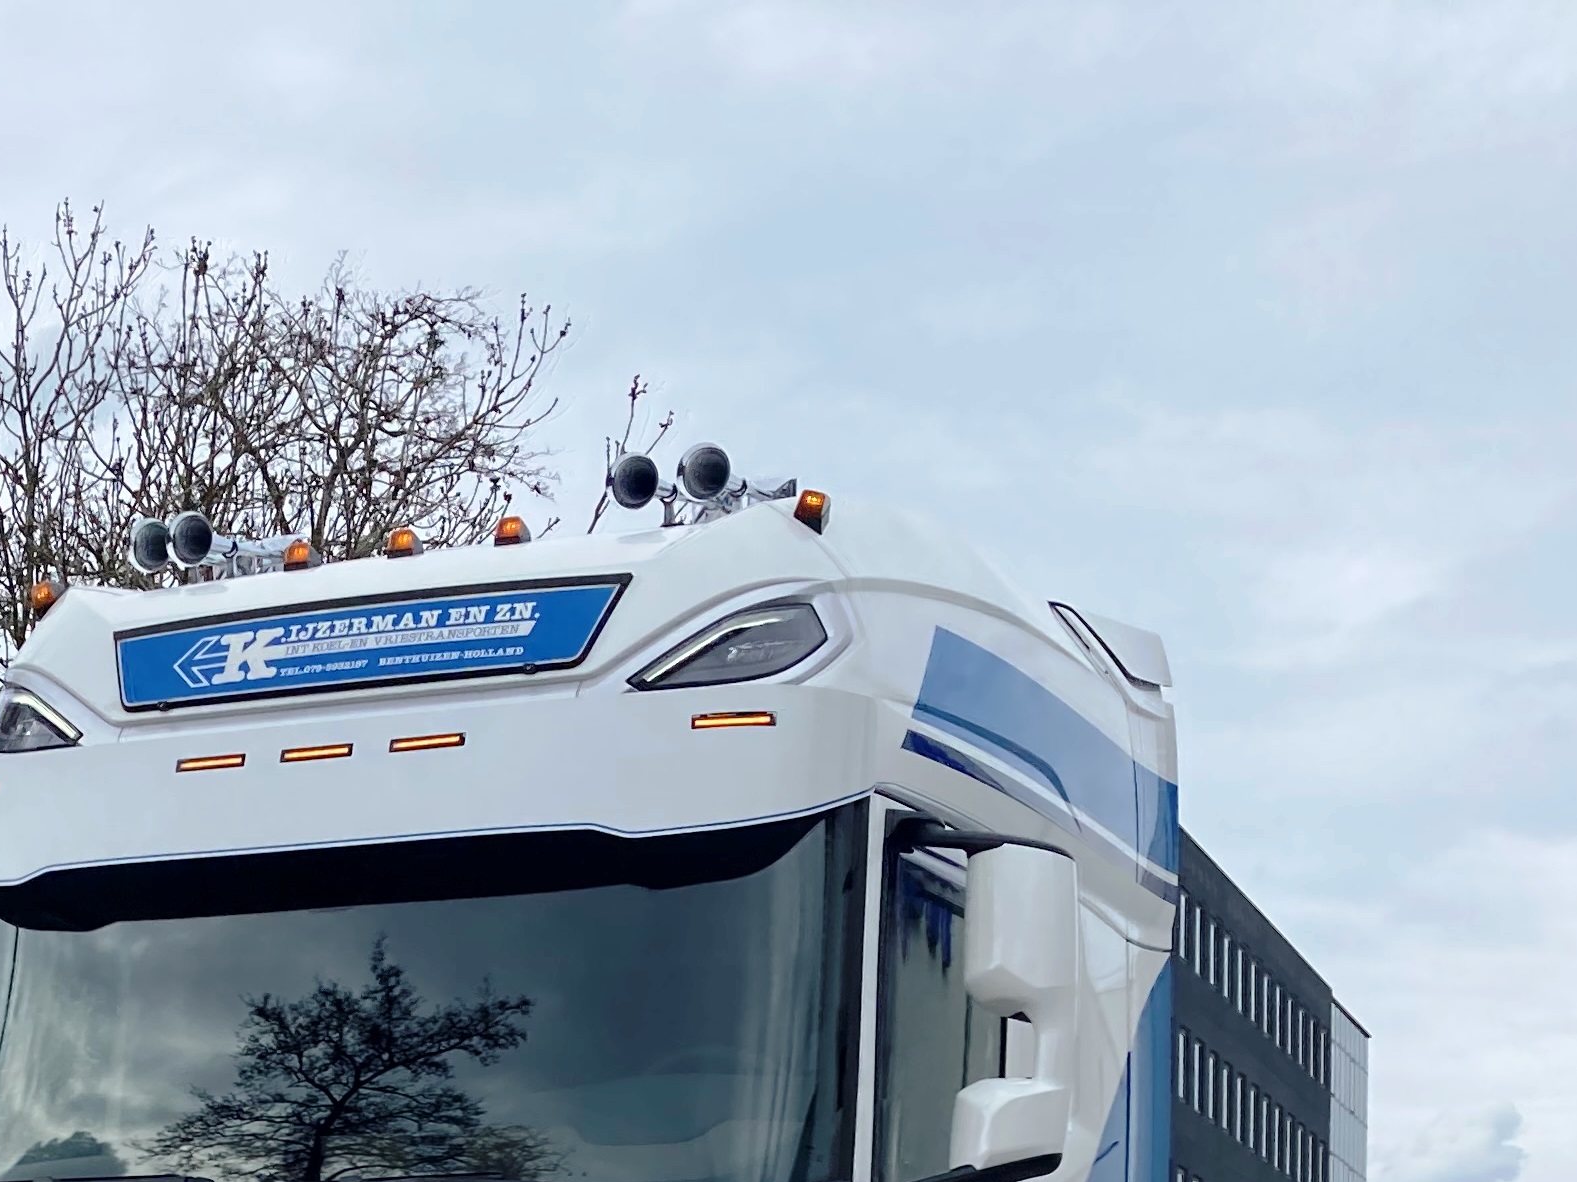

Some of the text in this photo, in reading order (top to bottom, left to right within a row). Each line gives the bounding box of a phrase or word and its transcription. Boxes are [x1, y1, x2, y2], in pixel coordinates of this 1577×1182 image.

[446, 605, 490, 625] EN
[494, 602, 540, 621] ZN.
[374, 624, 520, 645] VRIESTRANSPORTEN
